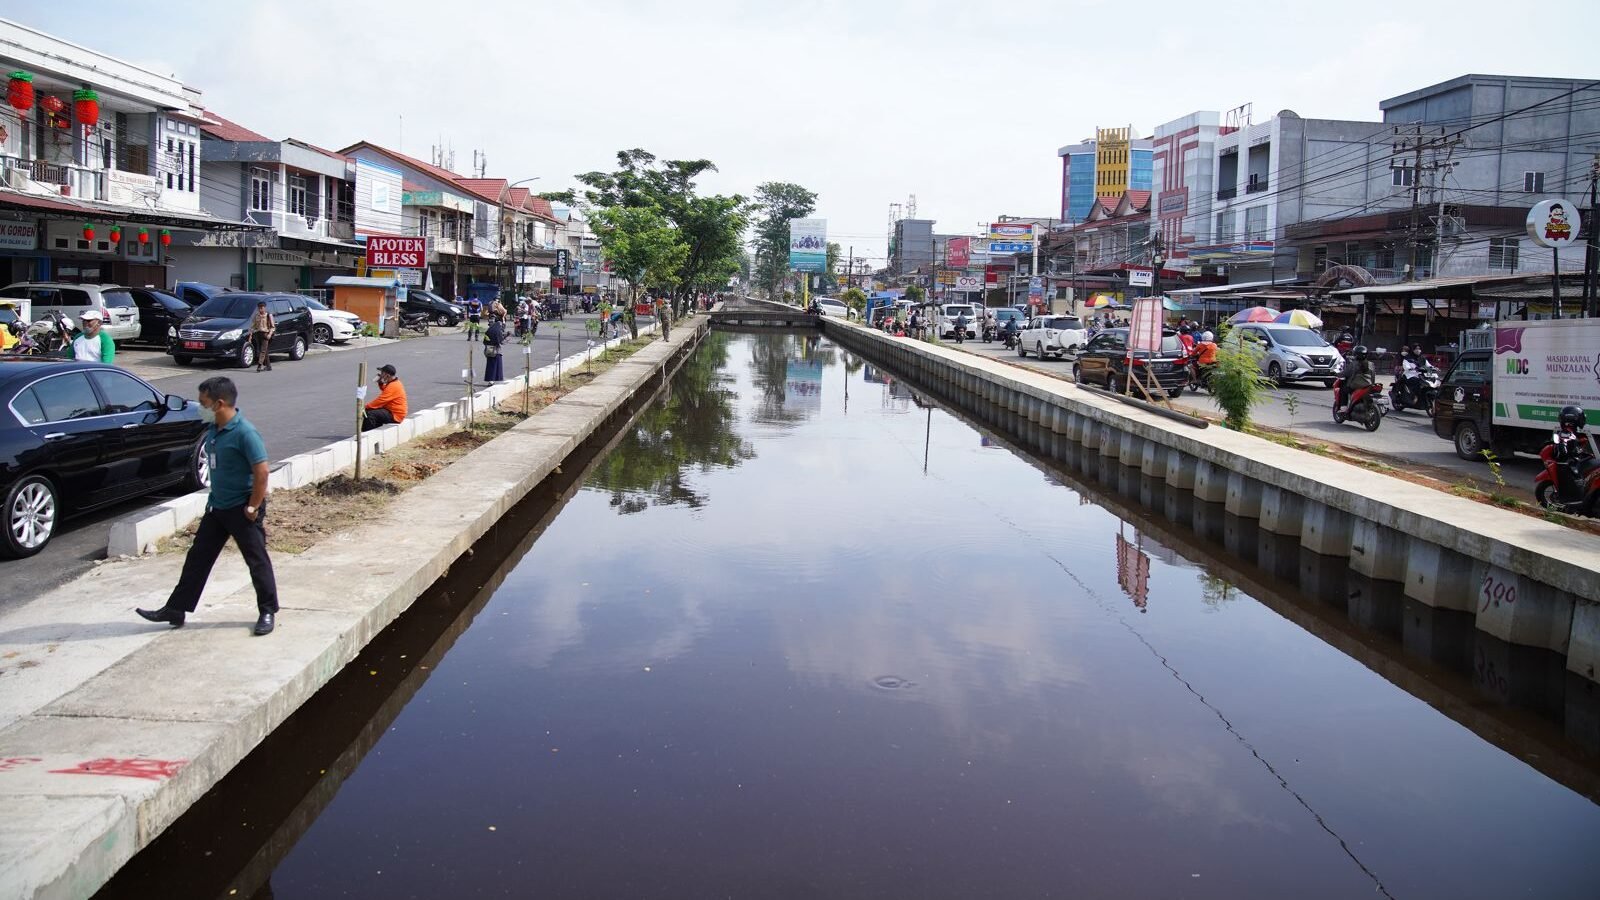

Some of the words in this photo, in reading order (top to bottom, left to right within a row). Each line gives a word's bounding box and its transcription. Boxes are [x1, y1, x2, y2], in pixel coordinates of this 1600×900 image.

[8, 225, 36, 237] GORDEN
[369, 239, 424, 252] APOTEK
[374, 252, 418, 265] BLESS
[1569, 355, 1591, 363] KAPAL
[1506, 358, 1529, 375] MDC
[1546, 363, 1591, 373] MUNZALAN
[1482, 577, 1516, 613] 300
